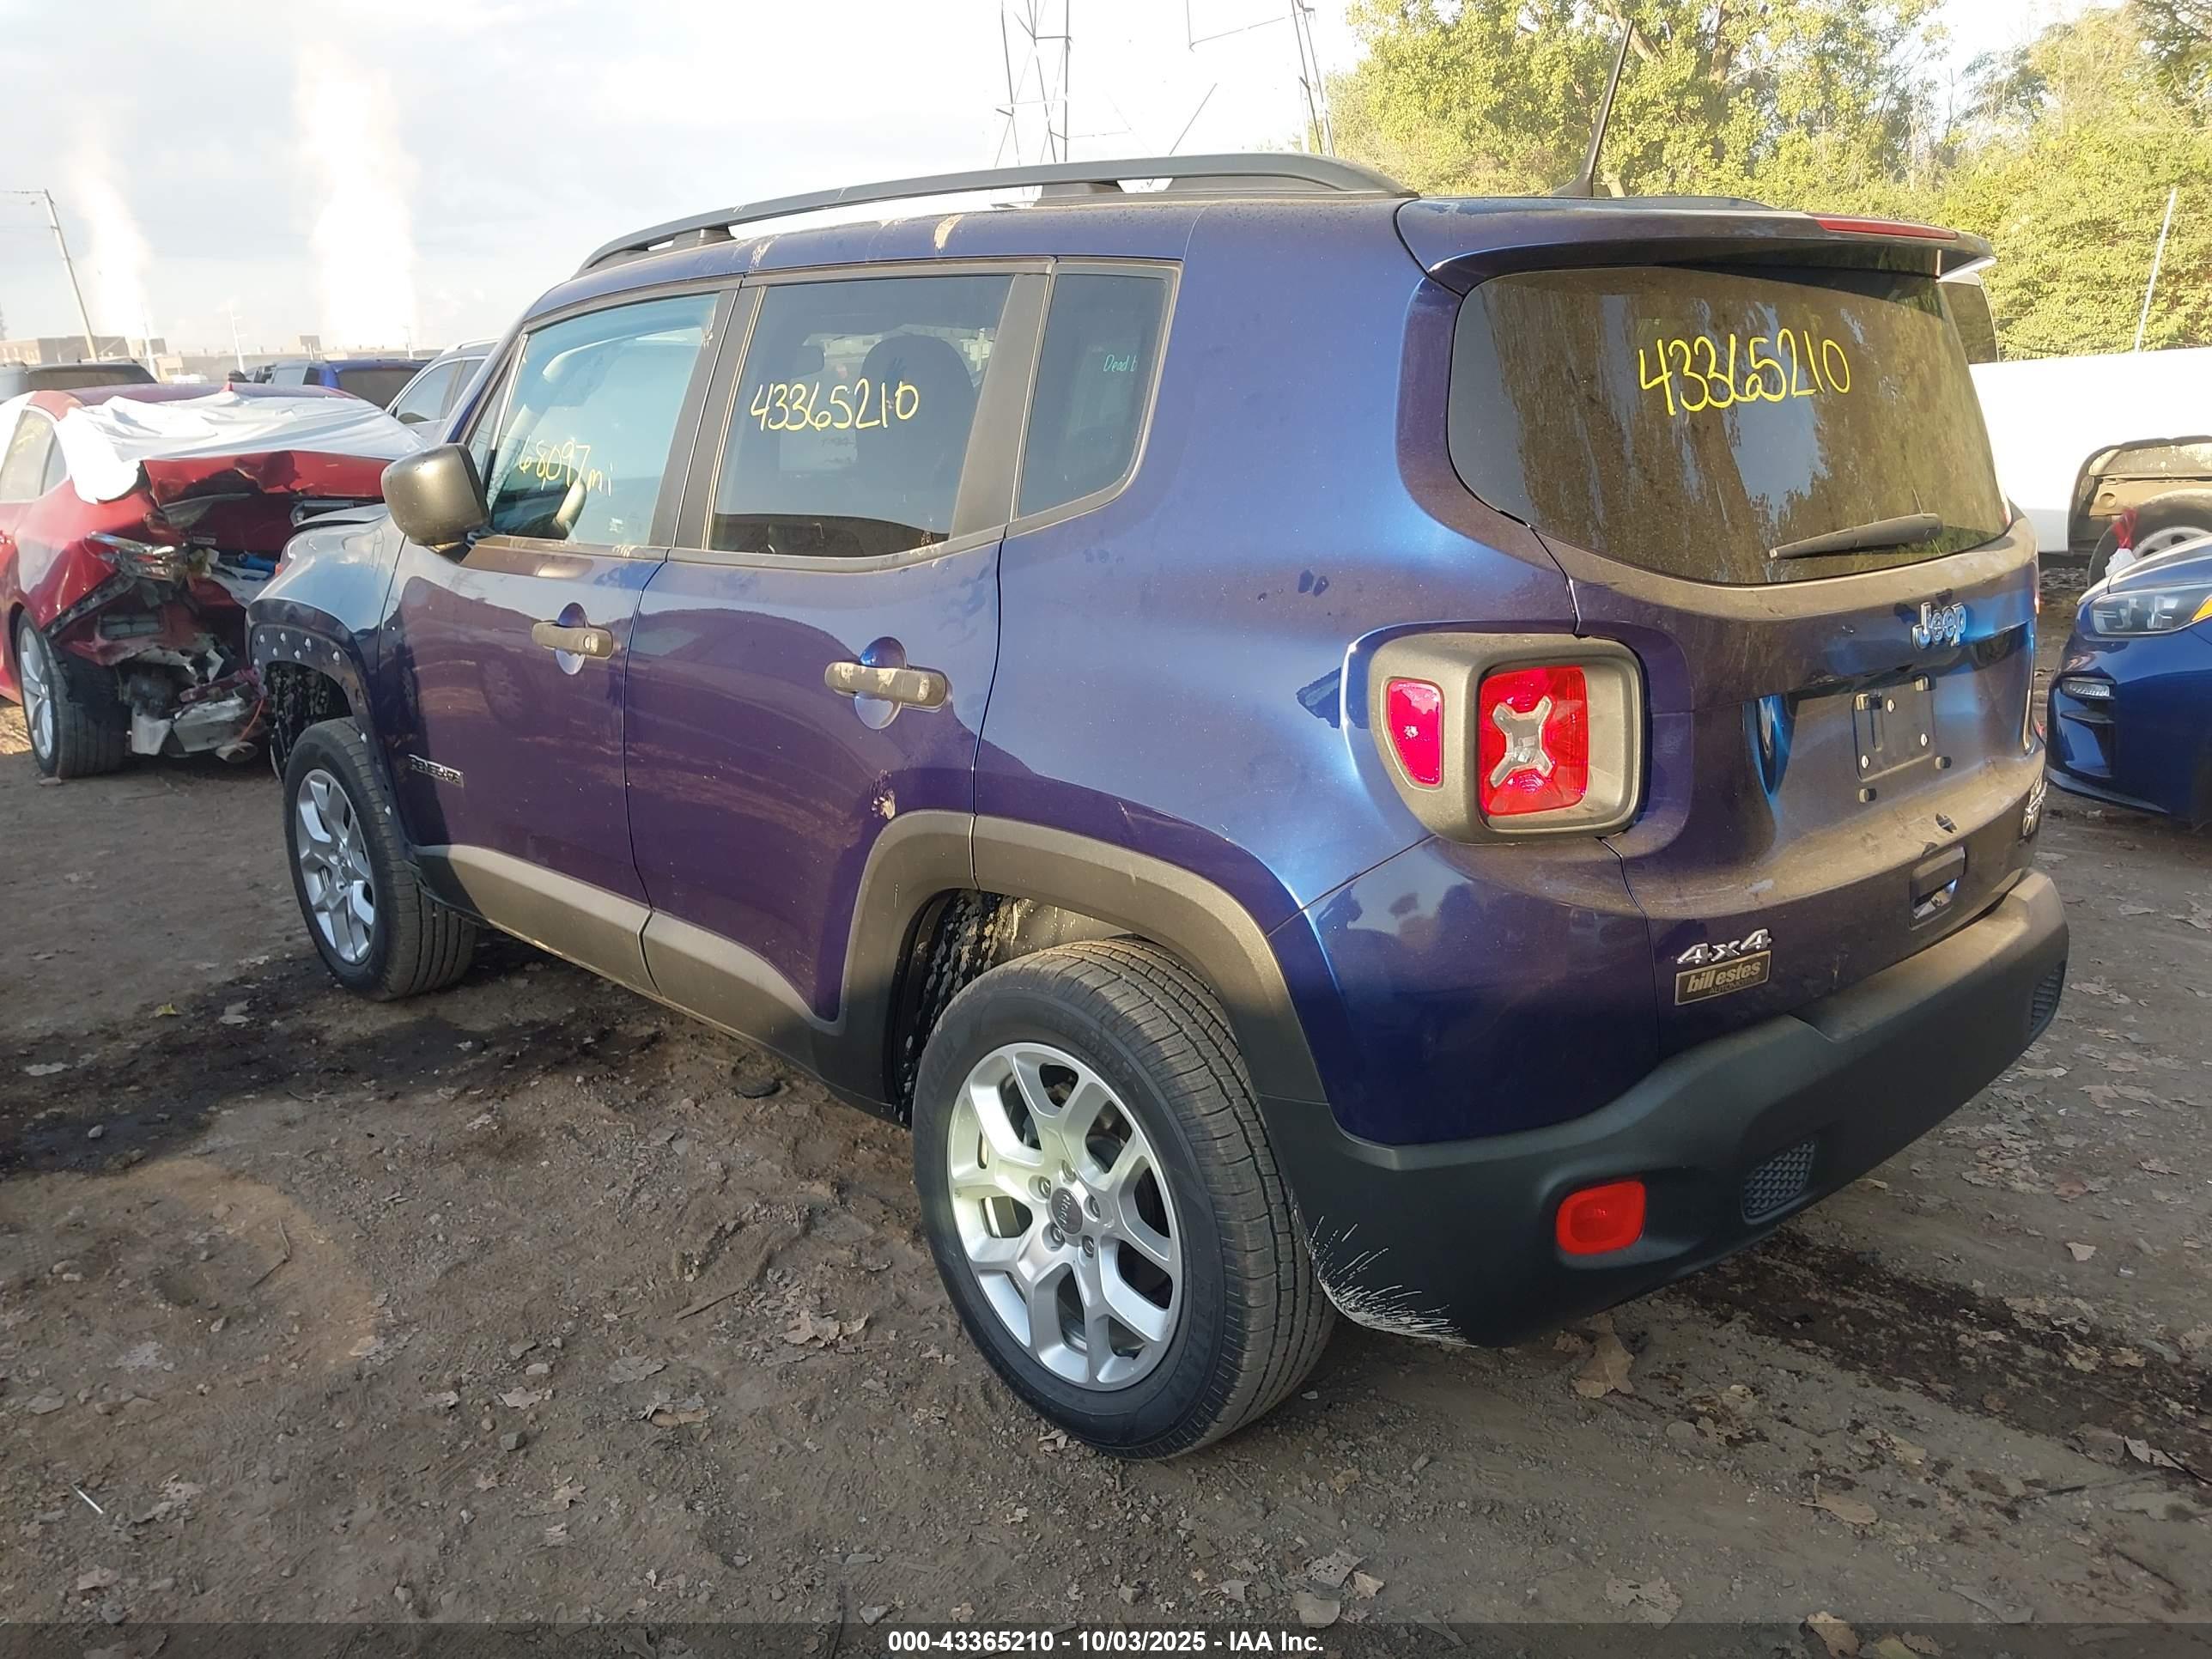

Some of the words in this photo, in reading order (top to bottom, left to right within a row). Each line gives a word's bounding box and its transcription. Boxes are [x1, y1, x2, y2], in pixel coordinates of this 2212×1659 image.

[1638, 327, 1850, 416] 43365210
[750, 378, 920, 431] 43365210
[1911, 601, 1967, 650] Jeep
[1676, 927, 1773, 964] 4x4
[1686, 969, 1717, 994] bill
[1715, 961, 1761, 986] estes
